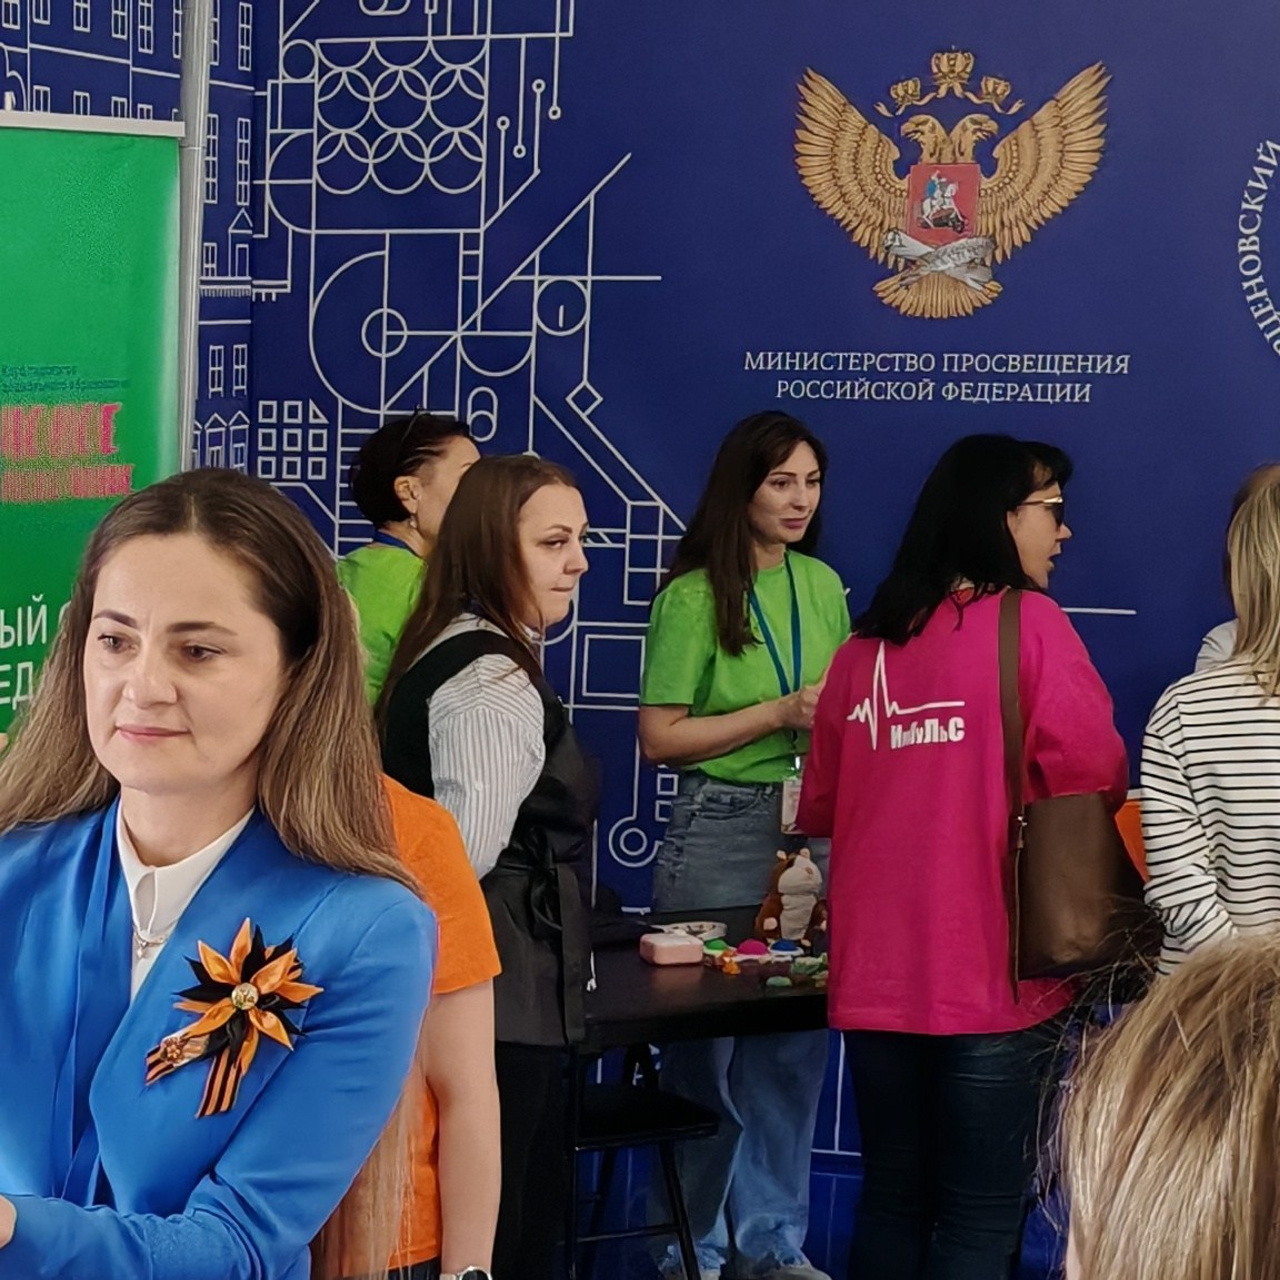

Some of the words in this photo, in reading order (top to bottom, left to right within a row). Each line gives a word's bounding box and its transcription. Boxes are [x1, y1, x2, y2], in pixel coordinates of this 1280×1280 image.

[744, 352, 934, 372] МИНИСТЕРСТВО
[942, 353, 1130, 375] ПРОСВЕЩЕНИЯ
[776, 377, 935, 401] РОССИЙСКОЙ
[942, 382, 1091, 404] ФЕДЕРАЦИИ
